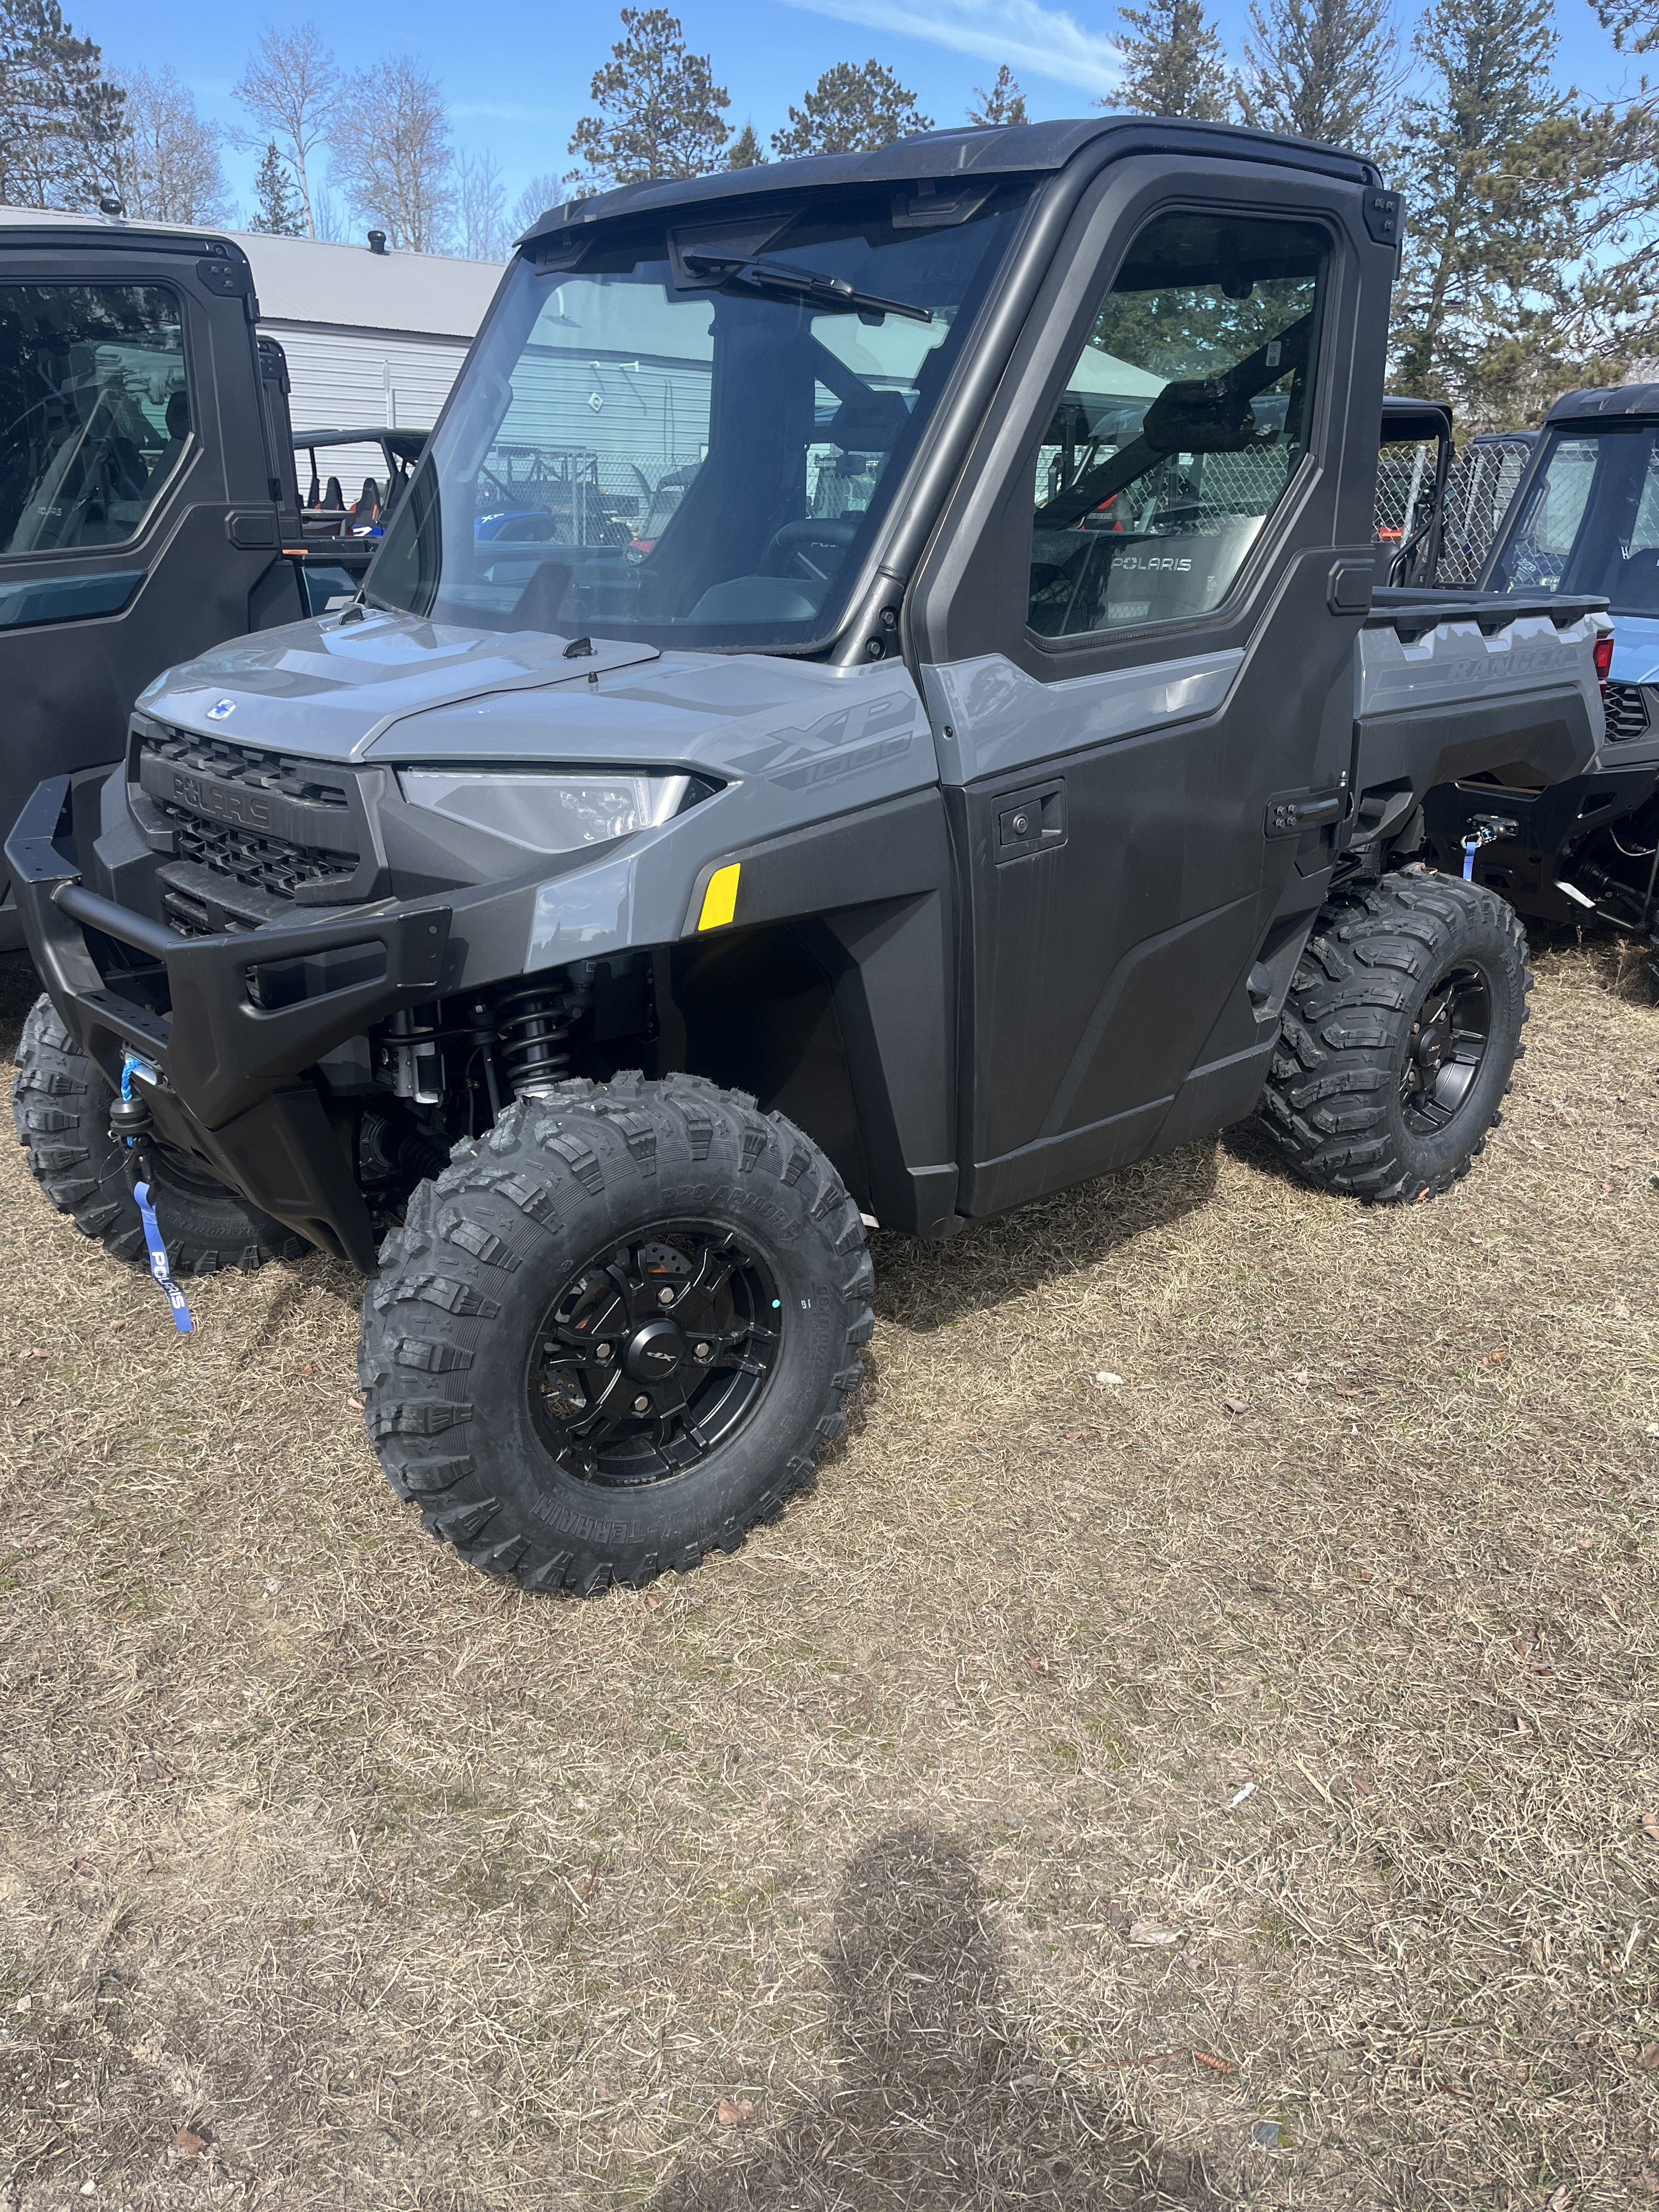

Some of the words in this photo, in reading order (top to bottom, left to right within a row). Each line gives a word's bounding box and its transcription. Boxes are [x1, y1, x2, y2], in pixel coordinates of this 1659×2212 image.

[1110, 557, 1193, 572] POLARIS
[1444, 645, 1570, 685] RANGER
[757, 690, 917, 774] XP
[804, 733, 912, 785] 1000
[172, 772, 270, 830] POLARIS
[659, 1184, 710, 1205] PRO
[710, 1186, 788, 1228] ARMOR
[151, 1251, 185, 1309] POLARIS
